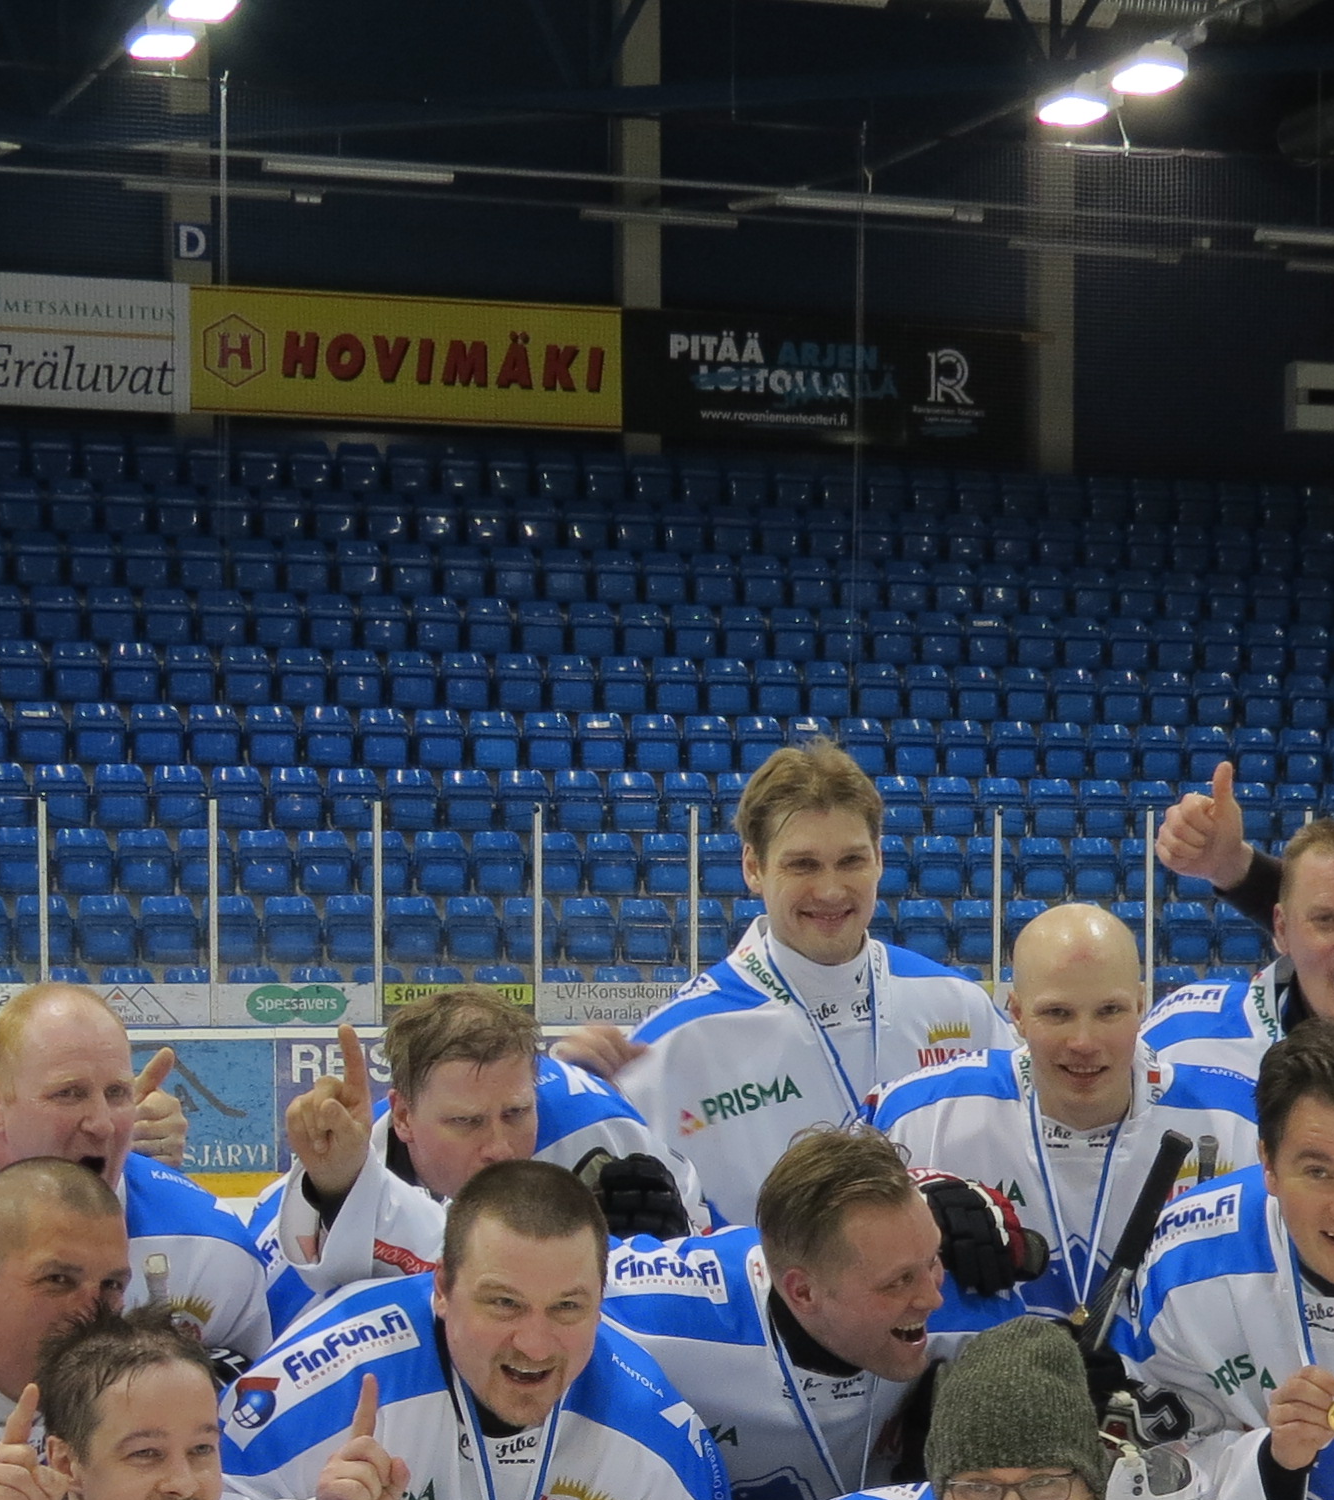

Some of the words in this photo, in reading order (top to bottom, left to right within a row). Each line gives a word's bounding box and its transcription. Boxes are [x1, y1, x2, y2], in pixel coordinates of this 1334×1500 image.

[179, 227, 206, 258] D
[281, 330, 605, 392] HOVIMÄKI
[669, 331, 765, 364] PITÄÄ
[777, 341, 879, 370] ARJEN
[744, 951, 792, 1006] PRISMA
[255, 995, 338, 1013] Specsavers
[702, 1073, 803, 1125] PRISMA
[282, 1309, 409, 1383] FinFun.fi
[610, 1351, 665, 1400] KANTOLA
